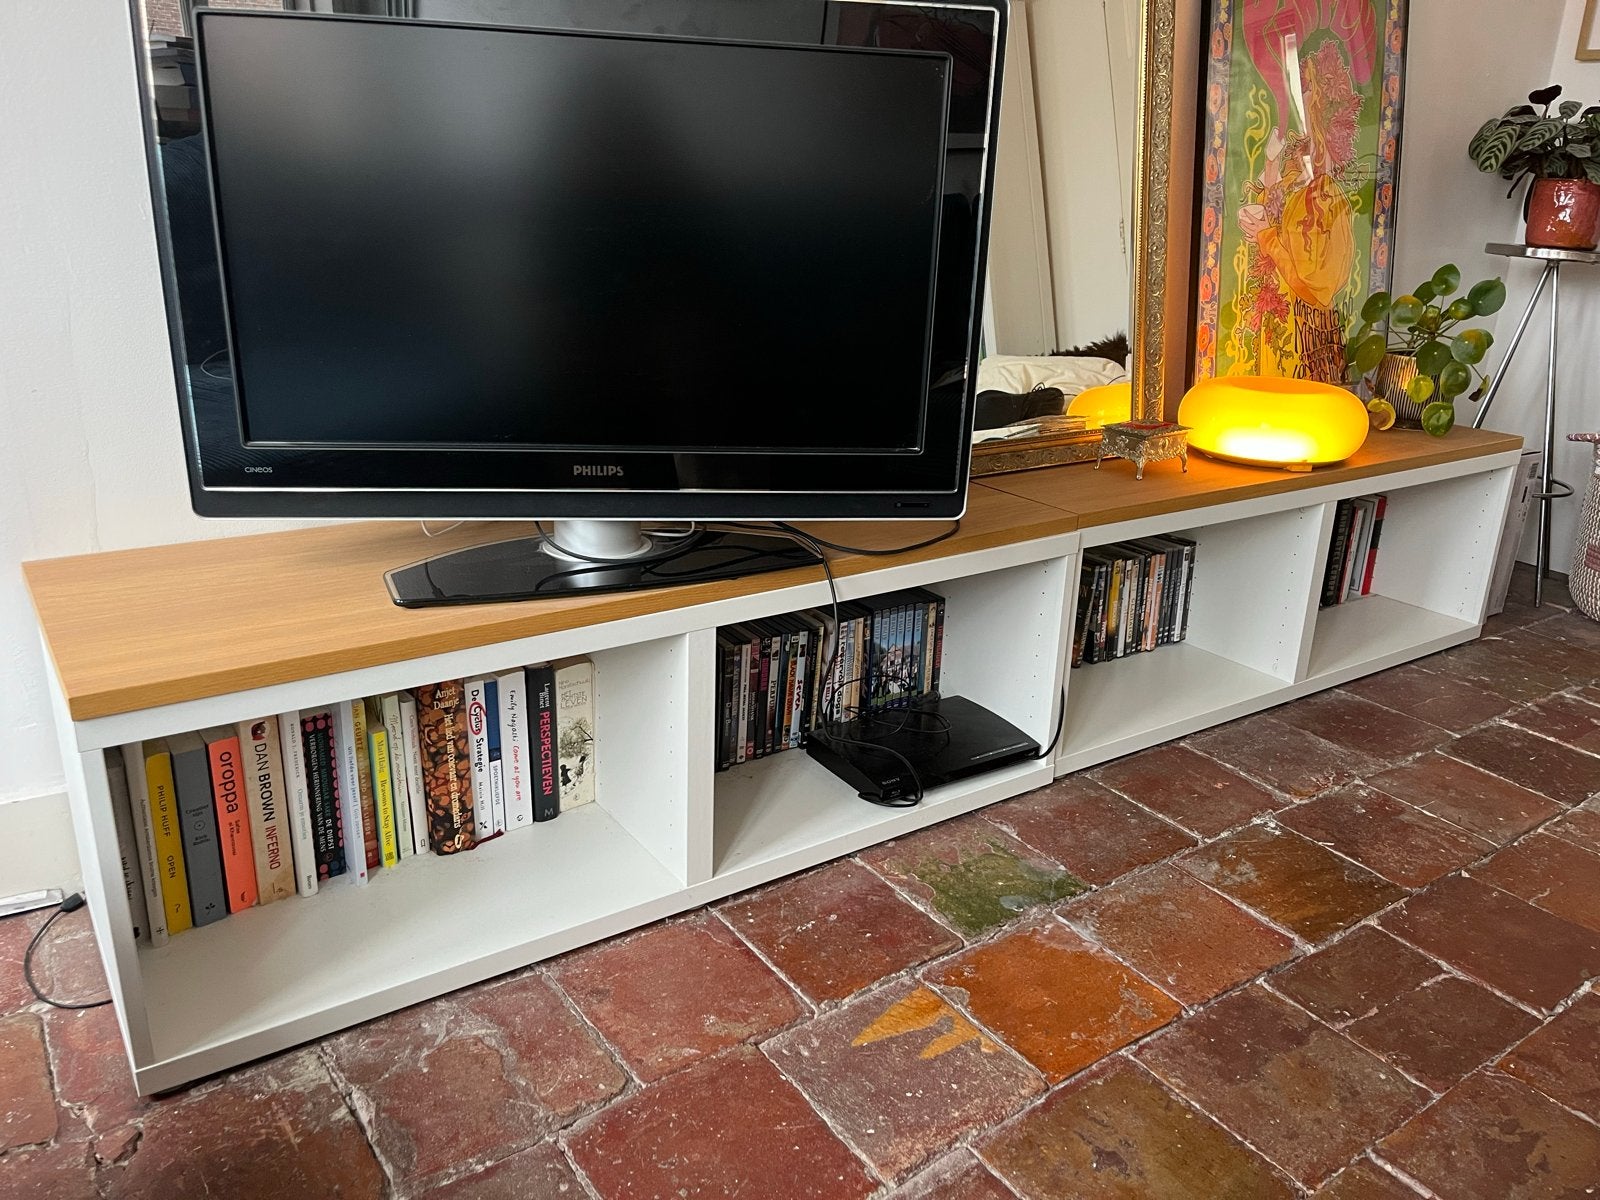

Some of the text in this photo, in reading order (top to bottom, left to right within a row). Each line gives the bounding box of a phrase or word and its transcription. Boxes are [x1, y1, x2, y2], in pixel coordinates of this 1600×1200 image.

[244, 465, 273, 474] CINEOS
[572, 464, 624, 477] PHILIPS
[433, 696, 460, 711] Daanje
[435, 687, 456, 699] Anjet
[472, 690, 479, 702] De
[509, 691, 517, 711] Emily
[445, 714, 453, 727] Het
[470, 706, 482, 732] Cyclus
[309, 734, 319, 771] VERBORGEN
[476, 738, 485, 773] Strategie
[540, 712, 553, 795] PERSPECTIEVEN
[447, 755, 458, 782] ooievaar
[218, 750, 239, 814] oroppa
[313, 772, 323, 812] HERINNERING
[381, 780, 389, 807] Reasons
[451, 784, 457, 792] en
[255, 743, 281, 870] DAN BROWN INFERNO
[451, 792, 461, 828] dromedaris
[157, 785, 177, 879] PHILIP HUFF OPEN
[319, 827, 325, 835] DE
[326, 819, 332, 828] DE
[383, 815, 391, 829] Stay
